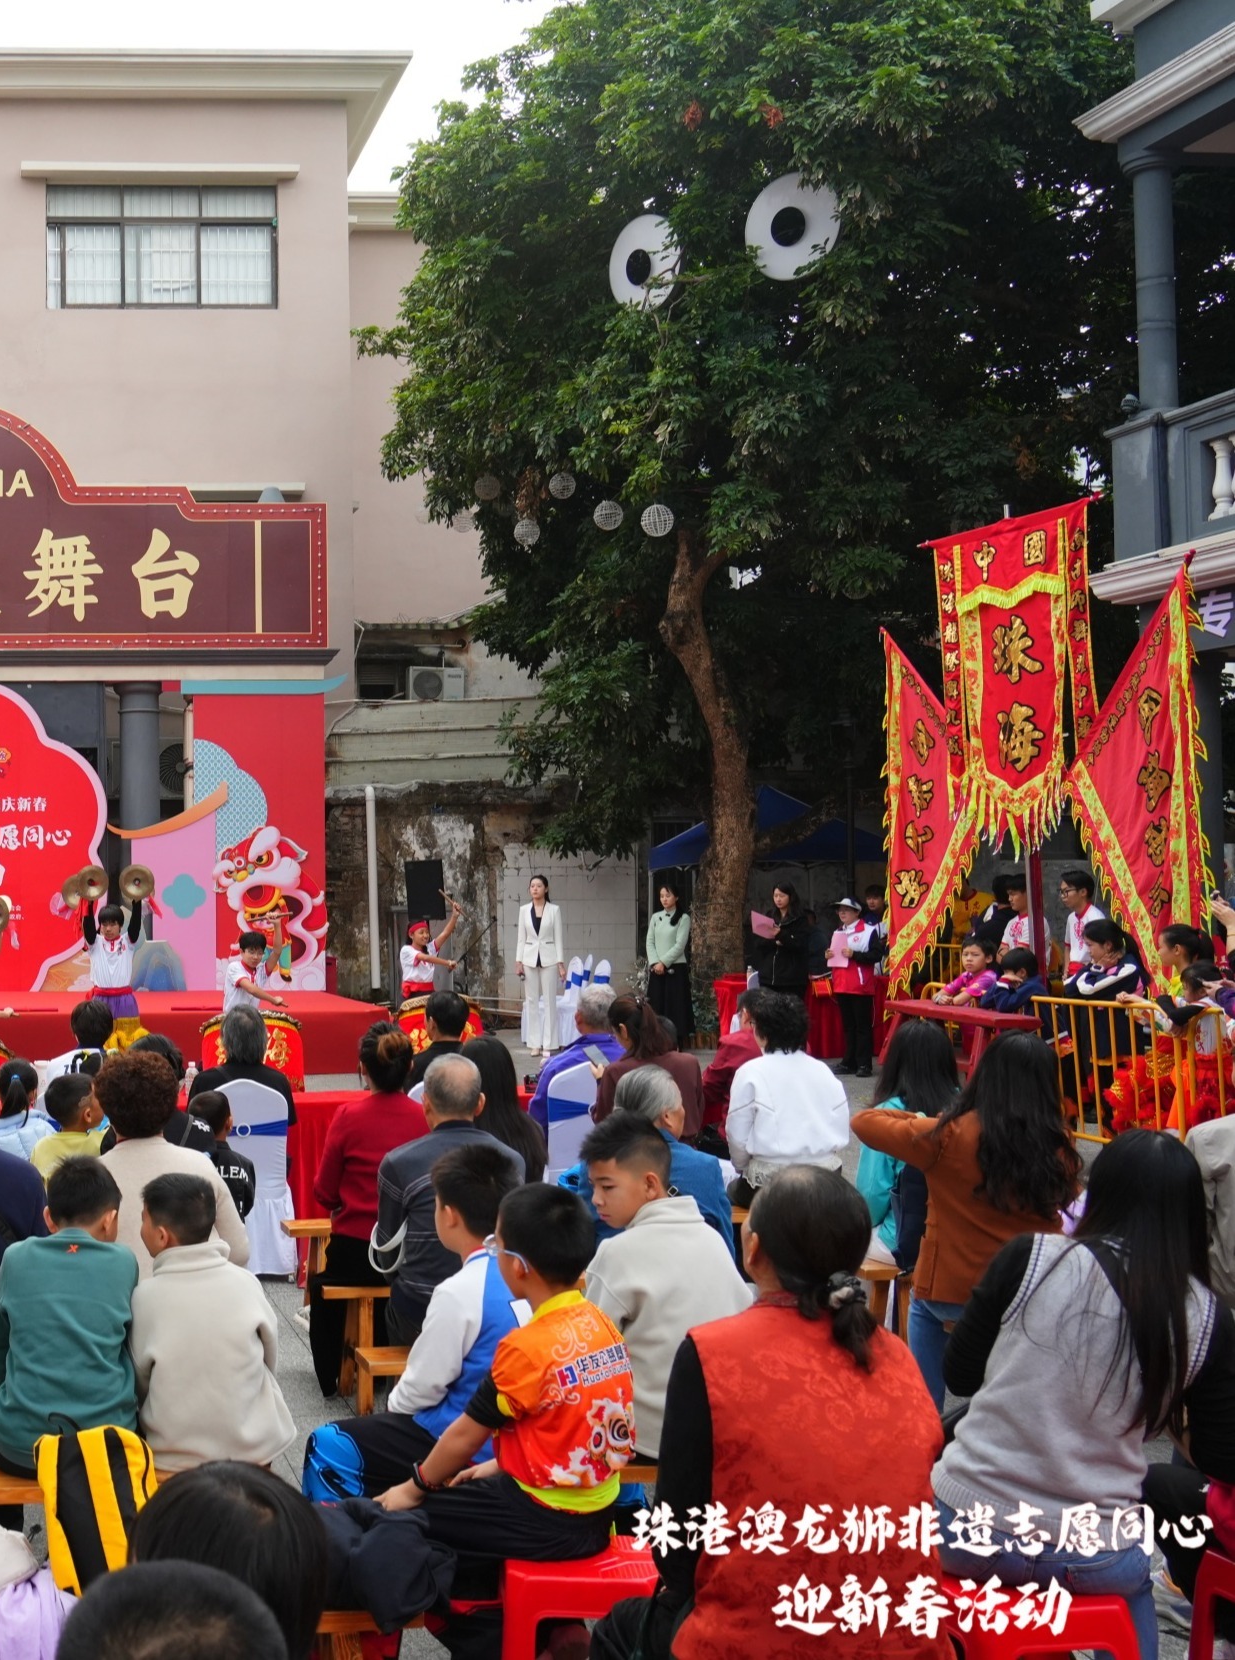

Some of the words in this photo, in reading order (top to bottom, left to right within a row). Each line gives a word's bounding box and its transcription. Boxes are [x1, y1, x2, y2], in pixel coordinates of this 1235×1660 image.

[972, 529, 1047, 583] 中國
[1198, 590, 1234, 638] 专
[991, 614, 1045, 774] 珠海
